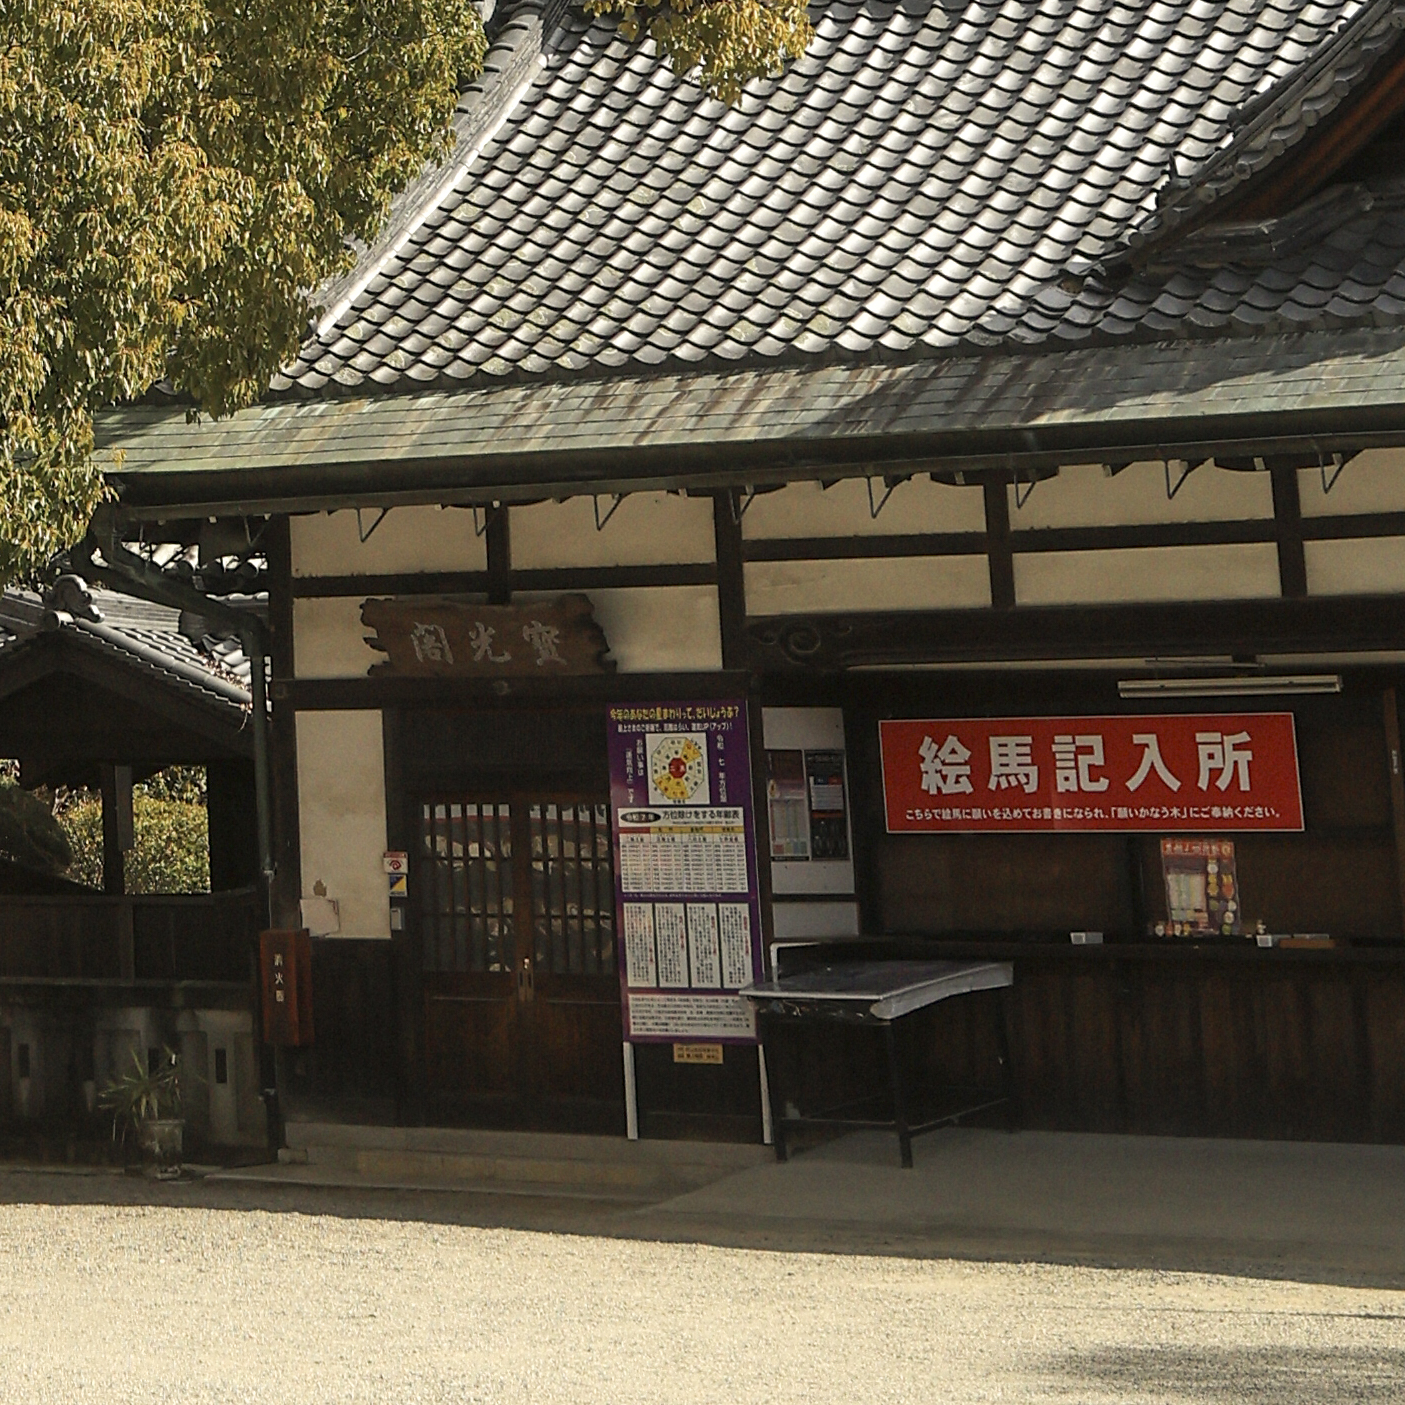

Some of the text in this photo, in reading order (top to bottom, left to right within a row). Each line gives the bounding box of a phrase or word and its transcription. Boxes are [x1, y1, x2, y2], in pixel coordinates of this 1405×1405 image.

[918, 731, 1254, 796] 絵馬記入所
